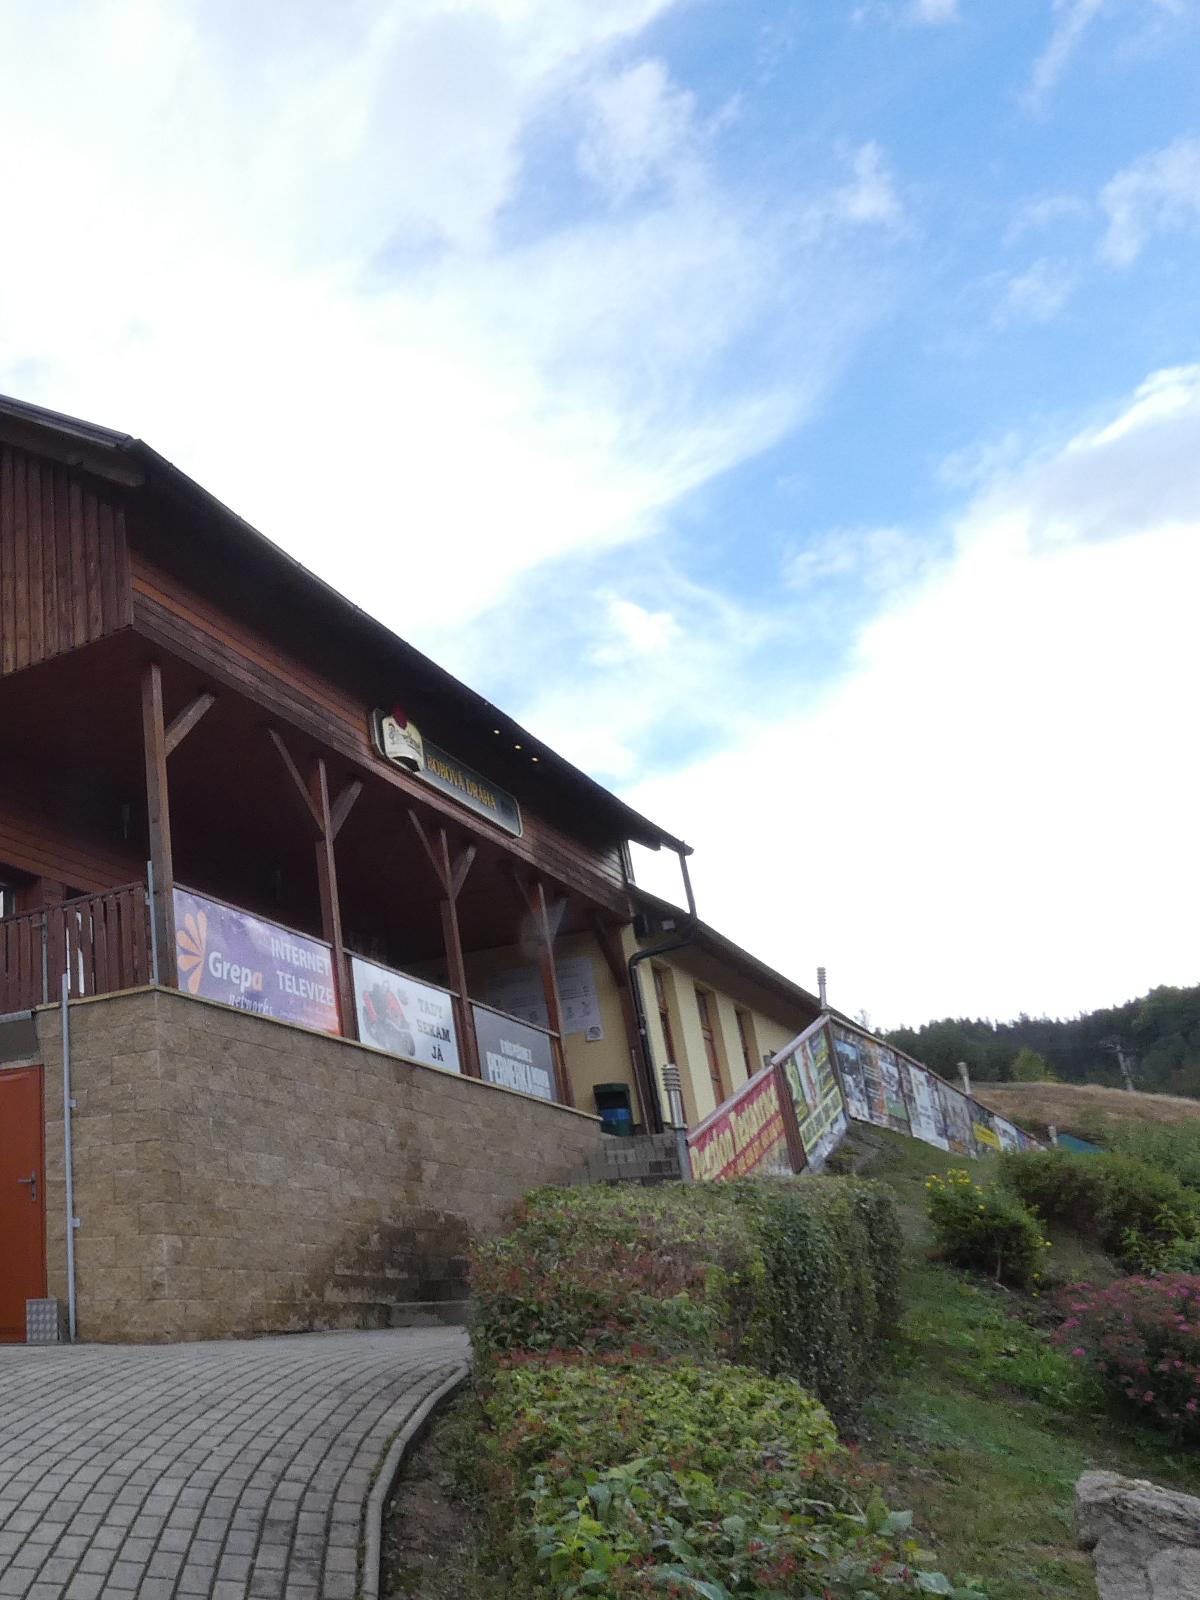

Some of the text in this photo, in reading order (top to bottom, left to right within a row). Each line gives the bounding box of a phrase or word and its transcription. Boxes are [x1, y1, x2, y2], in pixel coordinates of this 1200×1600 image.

[209, 951, 263, 993] Grepa
[271, 938, 331, 976] INTERNET
[229, 993, 273, 1016] networks
[277, 970, 335, 1006] TELEVIZE
[431, 1044, 444, 1062] JÁ
